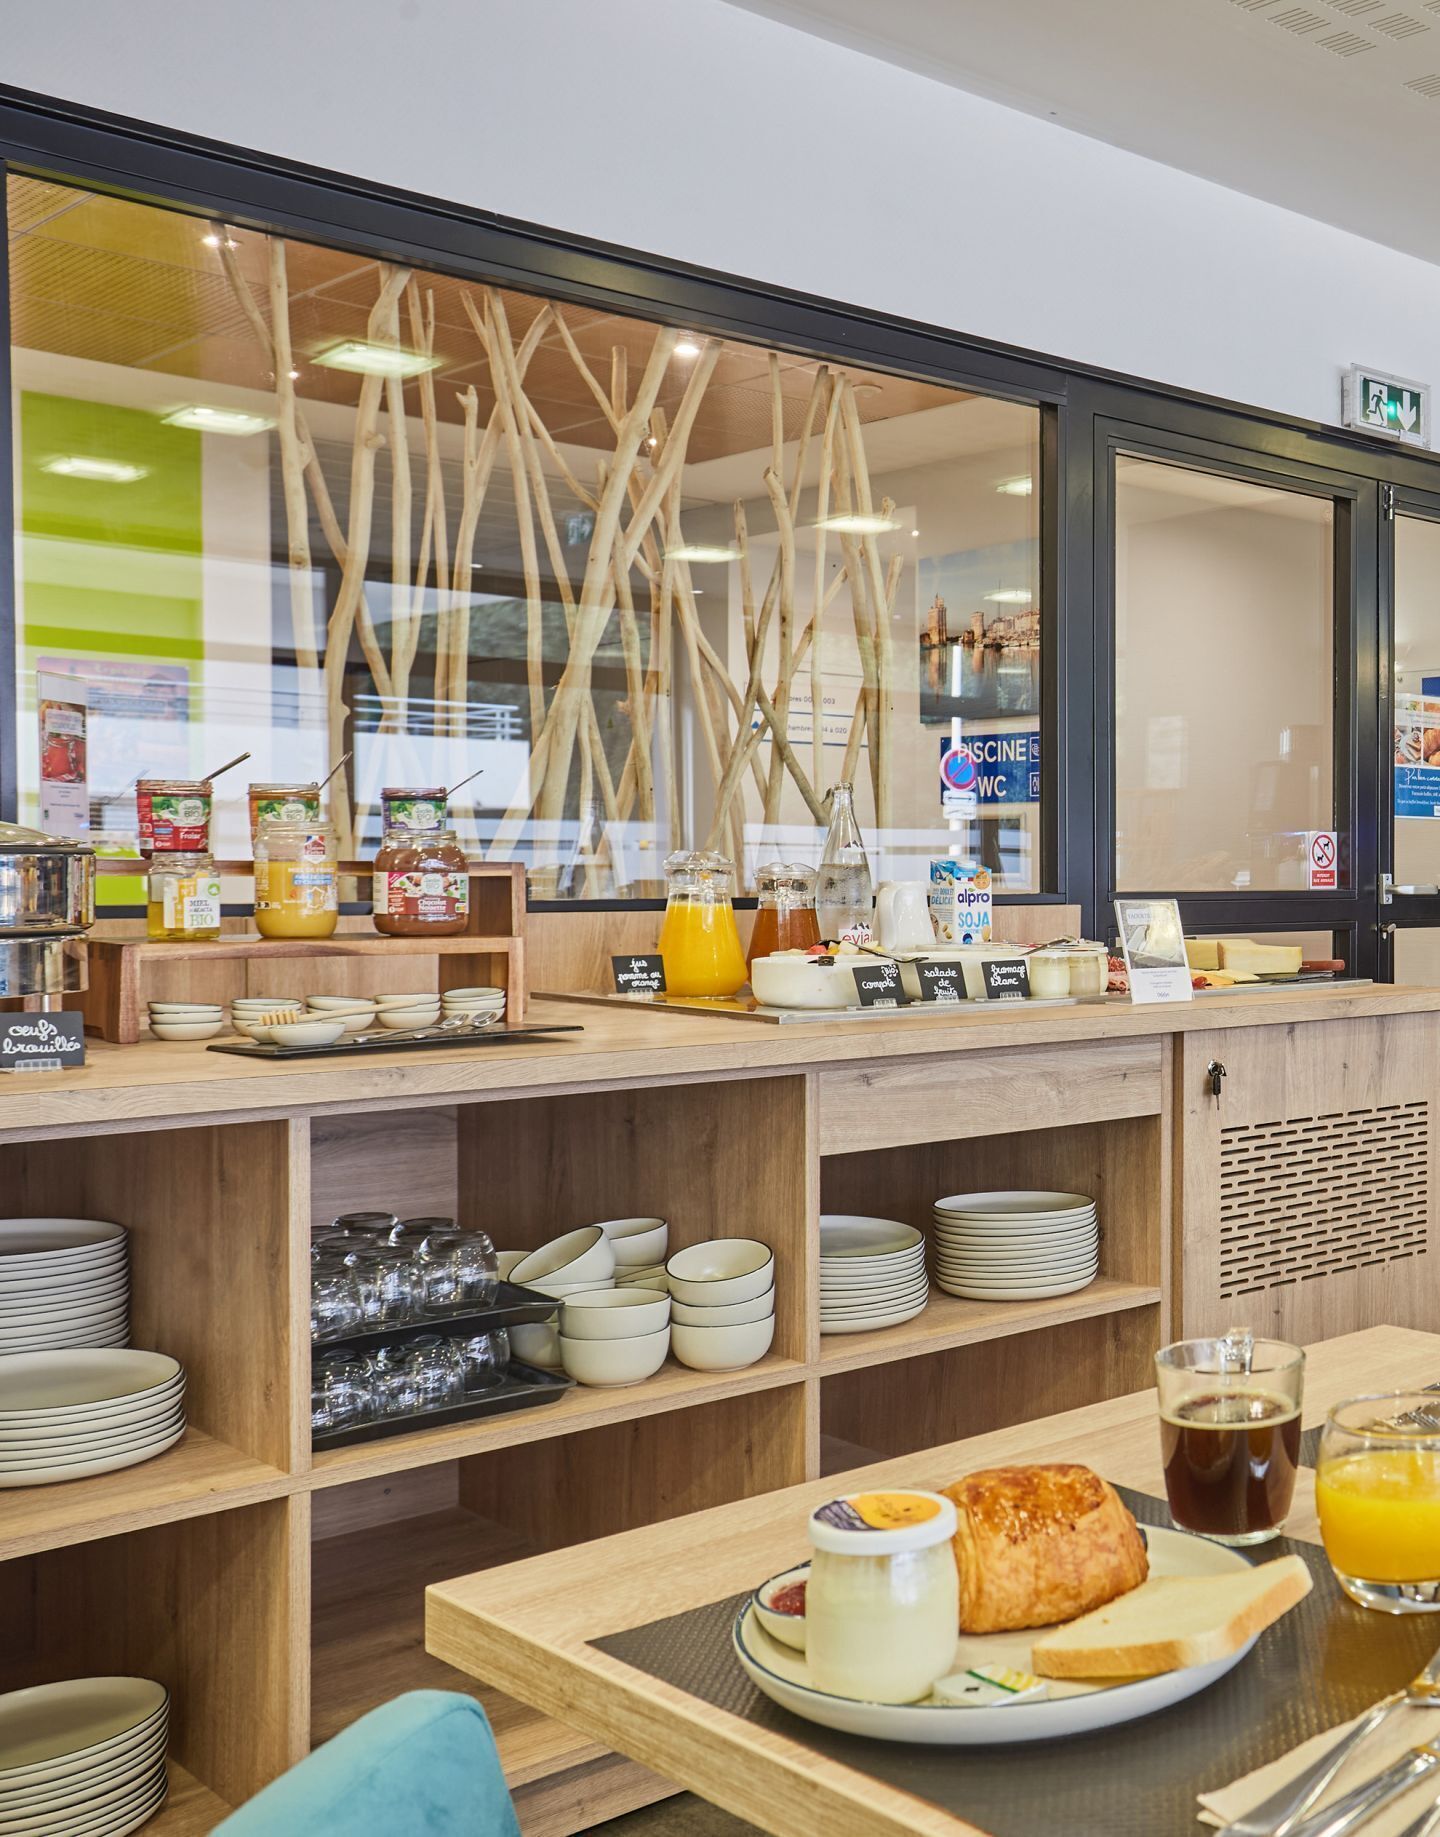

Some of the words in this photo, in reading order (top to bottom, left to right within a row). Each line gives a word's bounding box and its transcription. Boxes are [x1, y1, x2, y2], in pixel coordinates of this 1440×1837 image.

[957, 739, 1027, 764] PISCINE
[977, 775, 1007, 797] WC
[957, 888, 990, 907] alpro
[190, 913, 214, 926] BIO
[958, 911, 990, 928] SOJA
[842, 932, 873, 944] evia
[923, 966, 958, 978] salade
[990, 964, 1026, 980] fromage
[861, 976, 896, 993] compote
[938, 978, 951, 987] de
[990, 976, 1019, 987] blanc
[2, 1036, 81, 1054] brouillés
